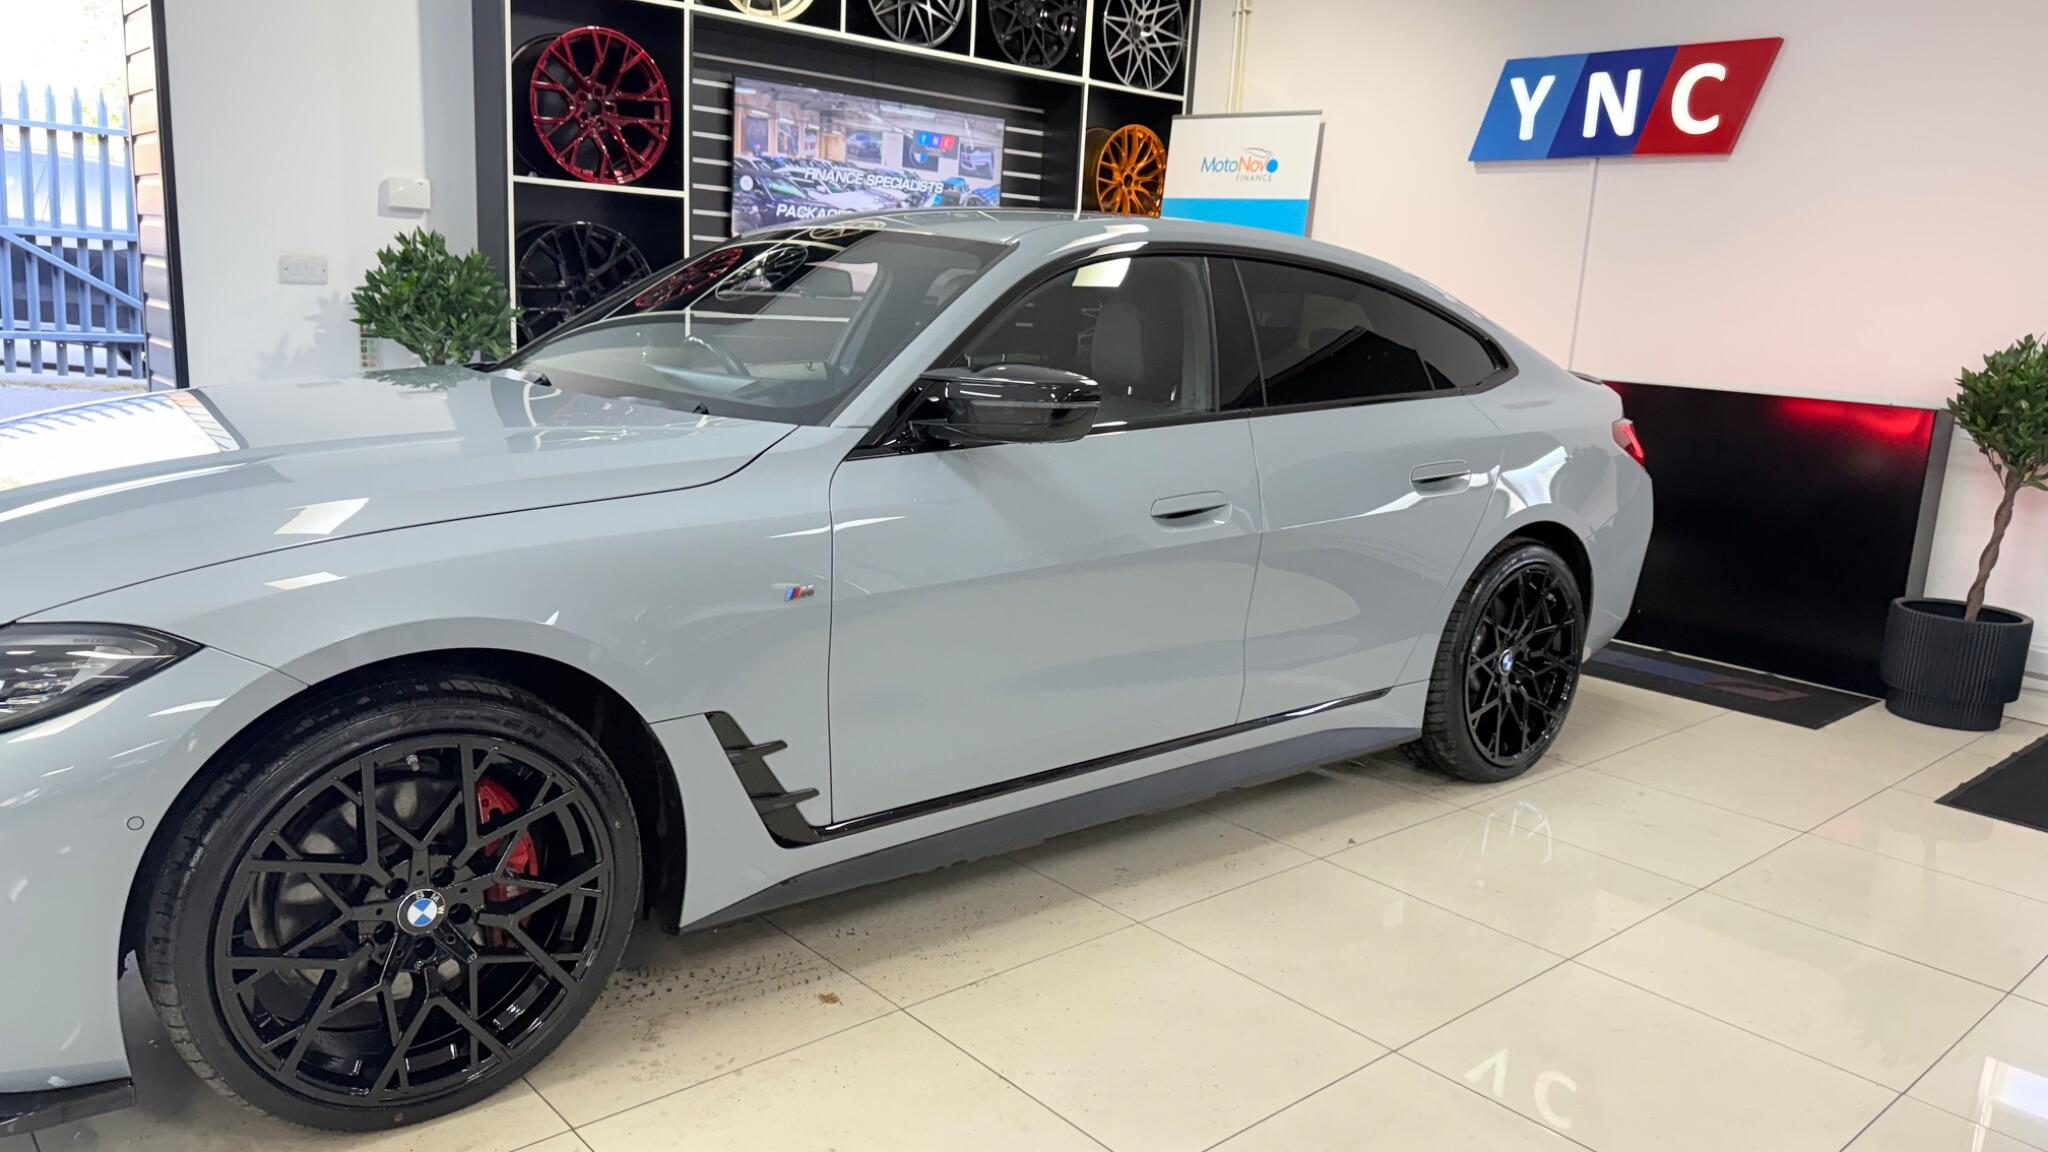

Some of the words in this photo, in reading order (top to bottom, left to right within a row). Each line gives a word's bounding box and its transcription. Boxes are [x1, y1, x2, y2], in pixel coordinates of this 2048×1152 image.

[1510, 62, 1727, 141] YNC
[1200, 156, 1279, 174] MotoNovo
[804, 167, 865, 185] FINANCE
[866, 174, 944, 194] SPECIALISTS
[1235, 174, 1273, 182] FINANCE
[415, 891, 445, 915] BMW
